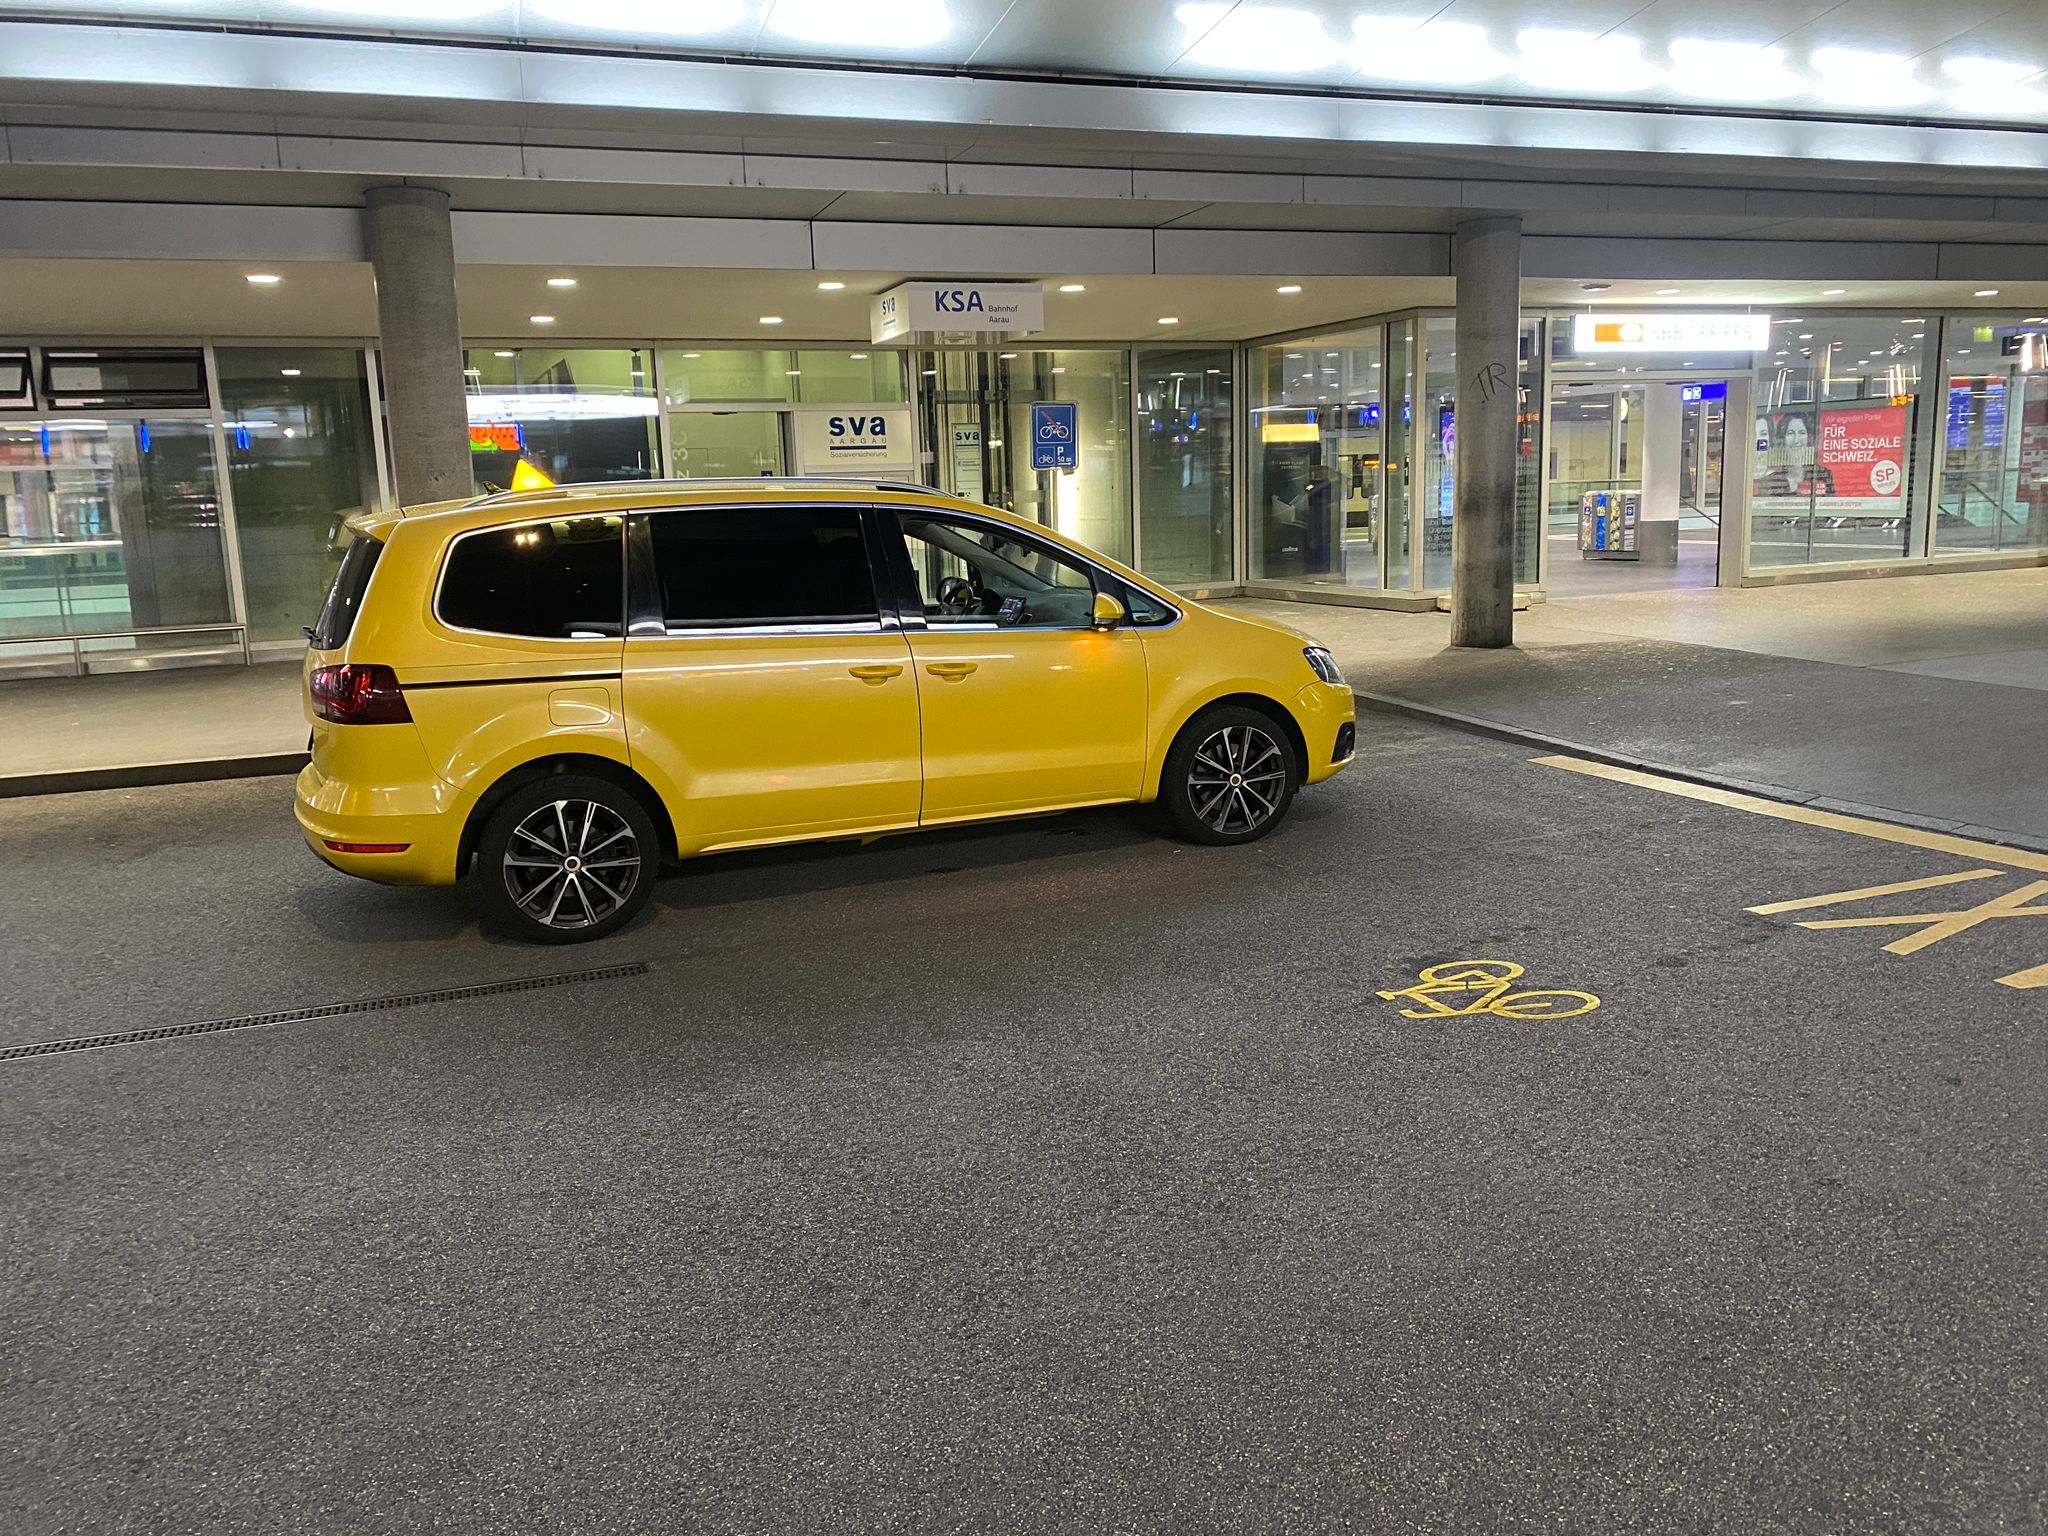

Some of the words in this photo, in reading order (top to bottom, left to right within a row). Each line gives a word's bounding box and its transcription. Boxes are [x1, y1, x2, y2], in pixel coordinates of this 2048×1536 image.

[882, 297, 896, 315] sva
[935, 291, 984, 312] KSA
[988, 305, 1018, 313] Bahnhof
[829, 416, 886, 436] sva
[1824, 424, 1846, 437] FÜR
[955, 431, 980, 441] sva
[1823, 439, 1848, 450] EINE
[1851, 436, 1901, 449] SOZIALE
[1057, 446, 1064, 456] P
[1822, 450, 1878, 462] SCHWEIZ.
[1876, 468, 1895, 482] SP
